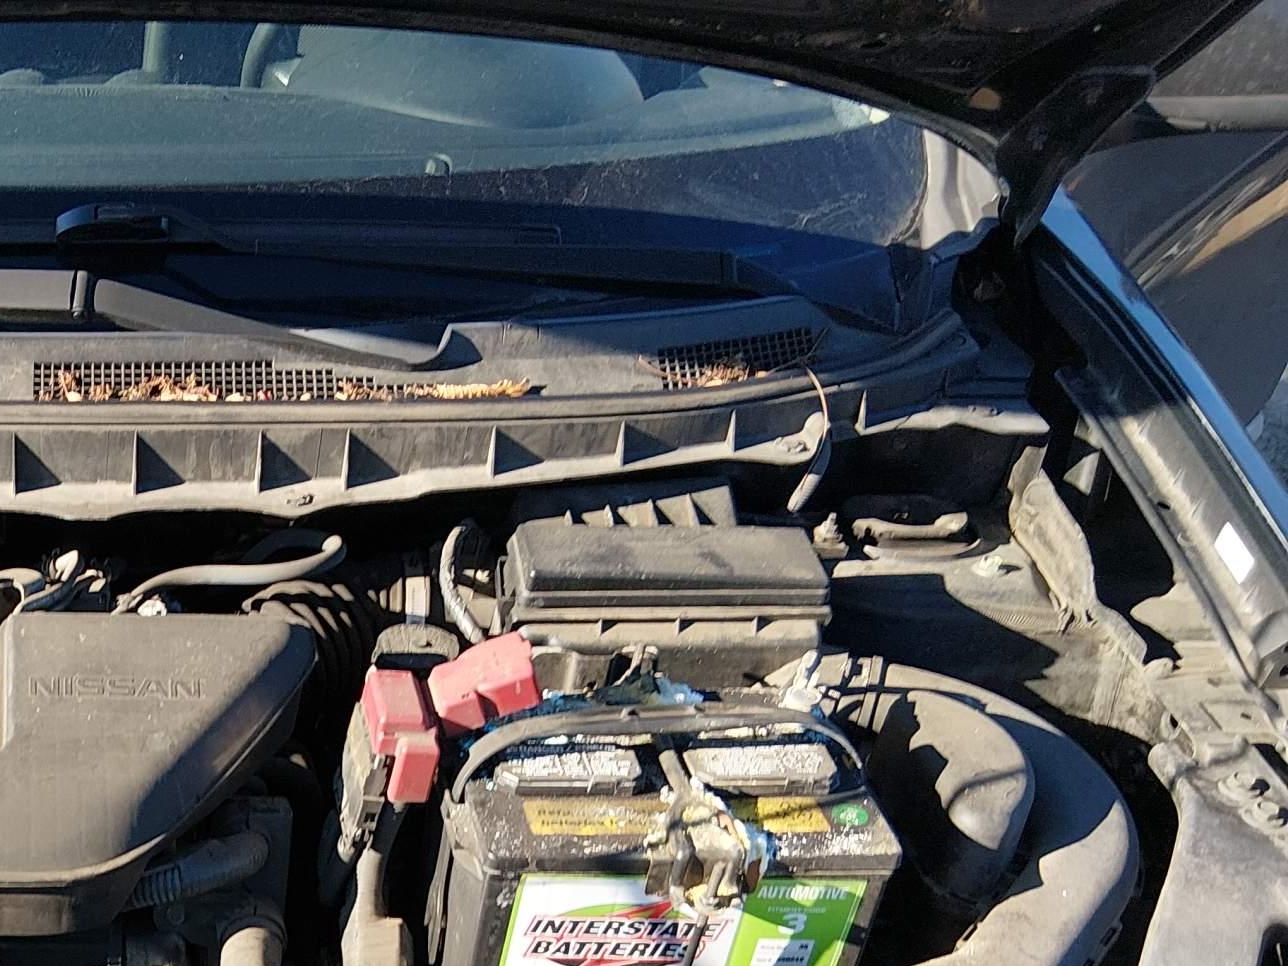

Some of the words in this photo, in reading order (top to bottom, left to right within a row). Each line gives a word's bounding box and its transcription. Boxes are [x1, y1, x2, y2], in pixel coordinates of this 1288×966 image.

[28, 675, 203, 699] NISSAN
[757, 885, 846, 900] AUTOMOTIVE
[529, 918, 721, 938] INTERSTATE
[777, 912, 808, 936] 3
